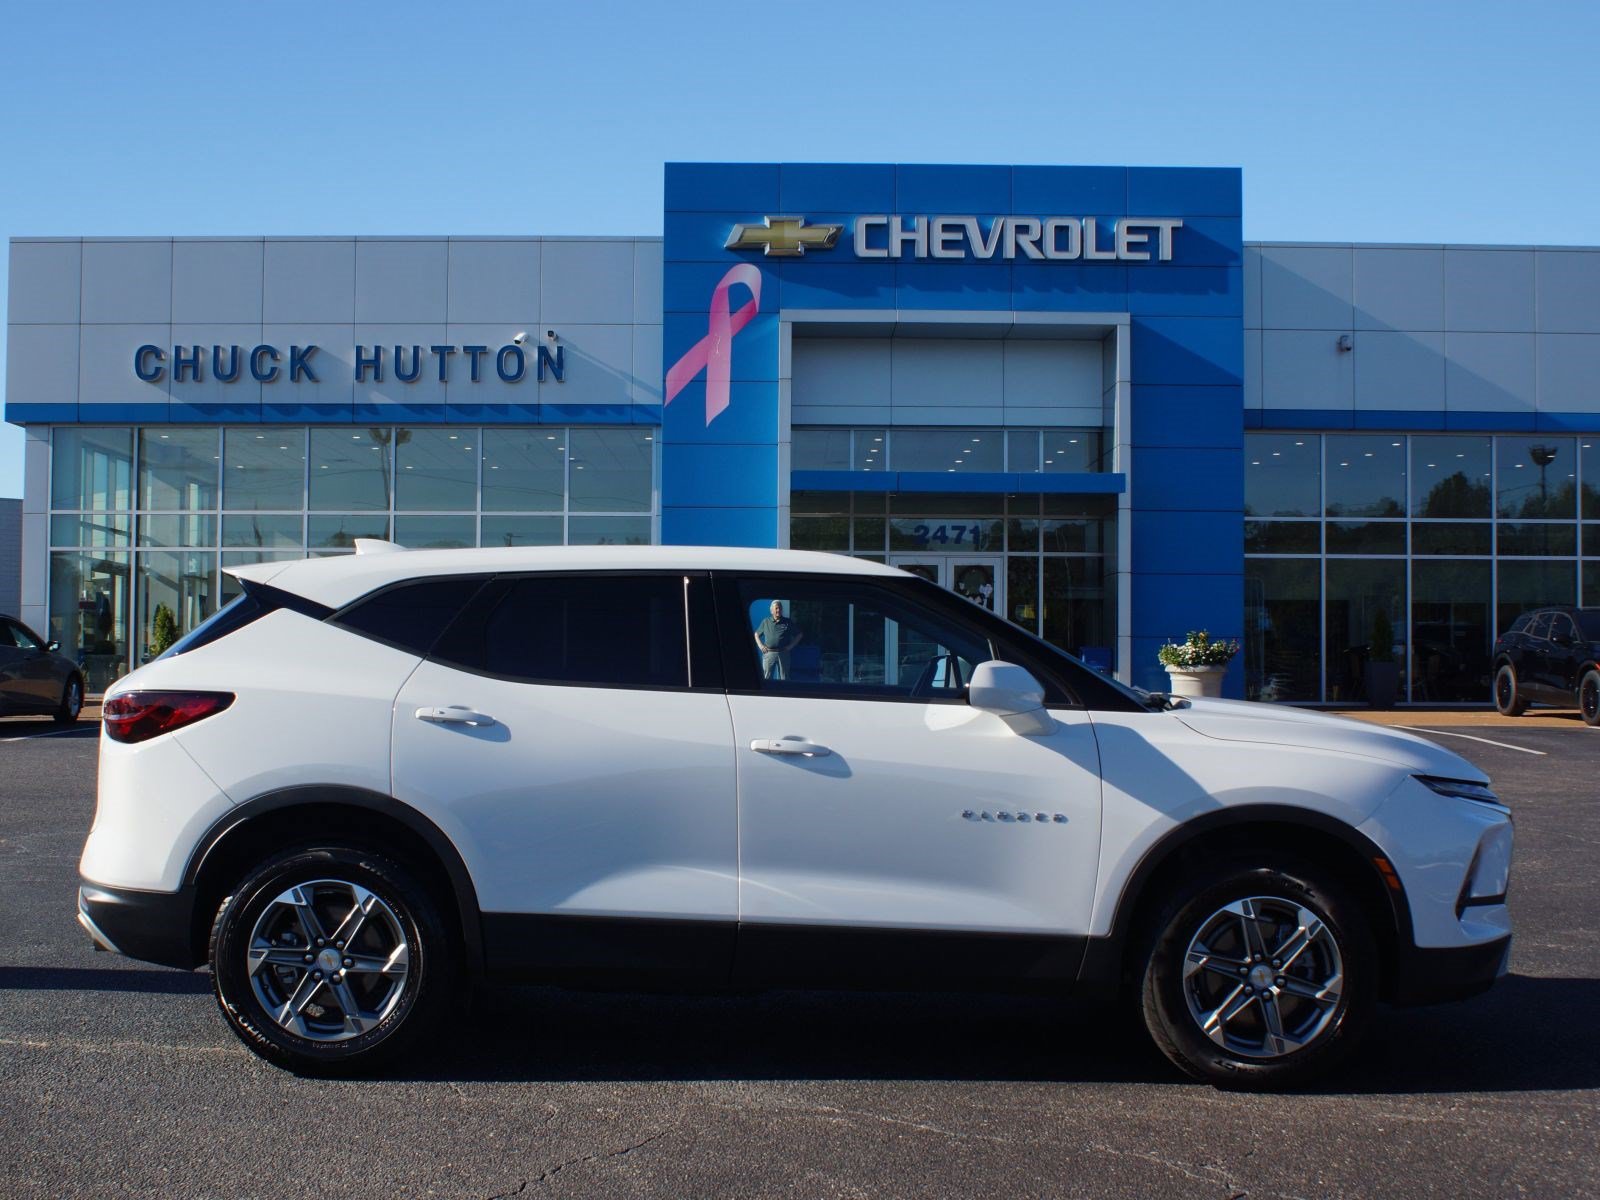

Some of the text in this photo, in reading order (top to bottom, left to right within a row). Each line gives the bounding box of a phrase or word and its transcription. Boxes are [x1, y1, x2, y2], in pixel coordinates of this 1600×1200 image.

[853, 215, 1183, 261] CHEVROLET
[134, 344, 565, 383] CHUCK HUTTON
[913, 524, 980, 545] 2471
